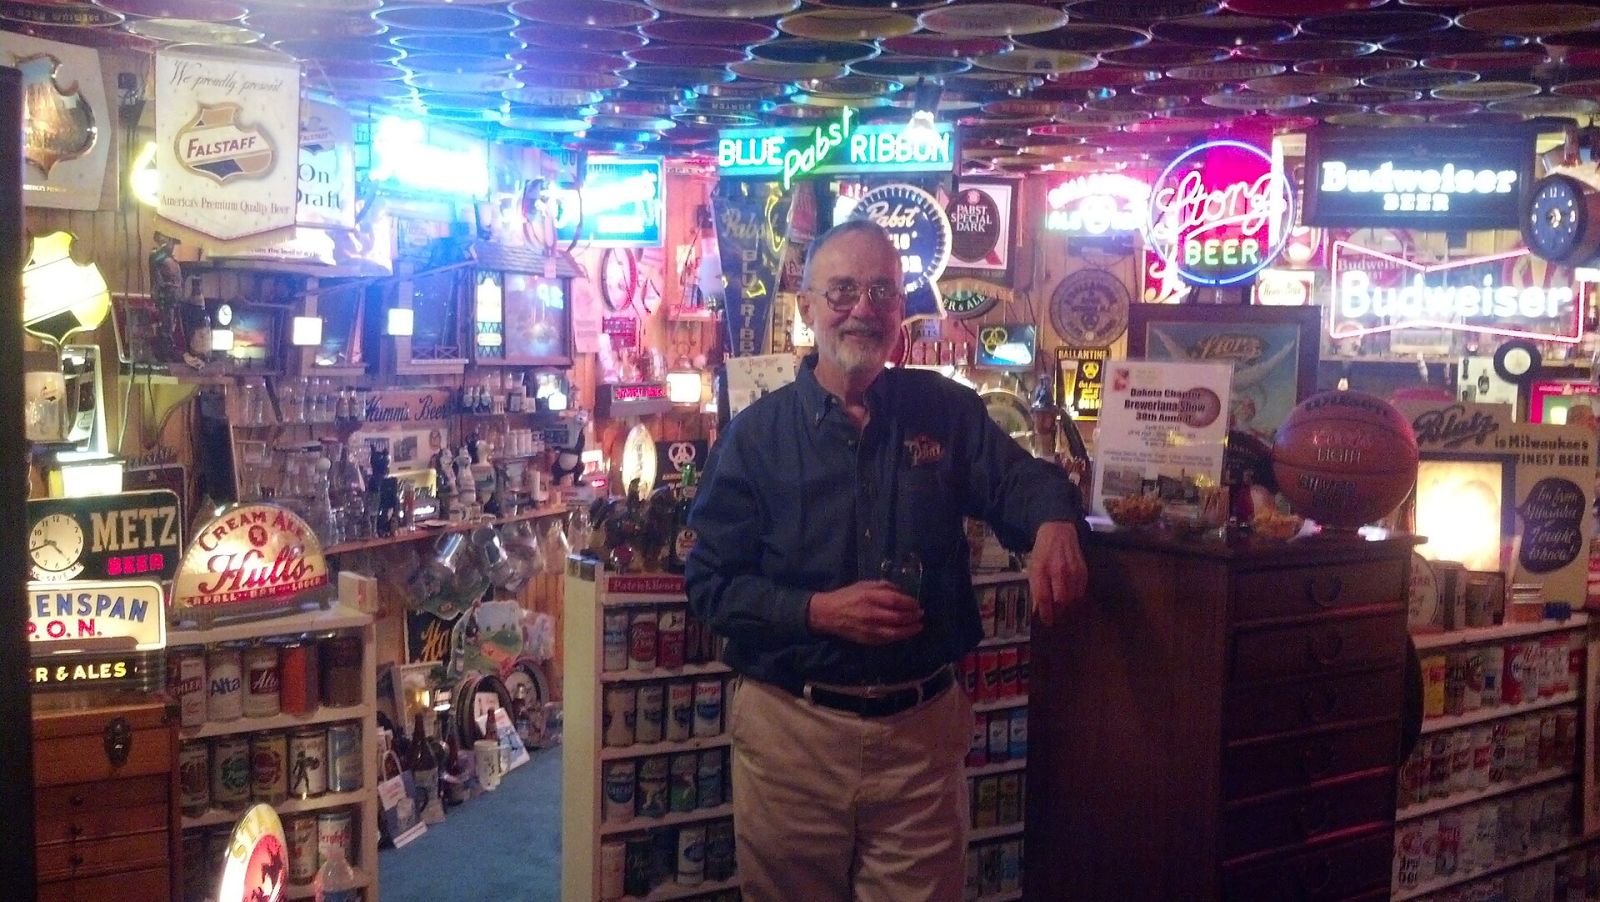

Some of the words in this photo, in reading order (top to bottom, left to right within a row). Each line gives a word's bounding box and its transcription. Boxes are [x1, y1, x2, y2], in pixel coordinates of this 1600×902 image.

[191, 71, 239, 95] proudly
[240, 79, 284, 94] present
[186, 135, 257, 159] FALSTAFF
[718, 136, 786, 168] BLUE
[850, 132, 950, 164] RIBBON
[299, 163, 331, 184] On
[1321, 161, 1518, 194] Budweiser
[201, 196, 238, 210] Premium
[240, 198, 268, 215] Quality
[269, 202, 291, 215] Beer
[956, 204, 988, 215] PABST
[1383, 193, 1450, 212] BEER
[866, 200, 920, 228] Pabst
[951, 213, 993, 225] SPECIAL
[956, 222, 986, 232] DARK
[1184, 239, 1259, 266] BEER
[1341, 271, 1573, 318] Budweiser
[1130, 387, 1163, 398] Dakota
[1164, 388, 1201, 401] Chapter
[364, 395, 409, 423] Hamm's
[415, 394, 448, 420] Beer
[1124, 399, 1178, 412] Breweriana
[1180, 400, 1206, 412] Show
[1158, 411, 1192, 424] Annual
[1495, 437, 1506, 449] is
[1558, 455, 1589, 467] BEER
[90, 505, 177, 553] METZ
[198, 511, 267, 552] CREAM
[108, 553, 164, 576] BEER
[36, 592, 149, 624] ENSPAN
[56, 666, 69, 682] &
[73, 662, 127, 680] ALES
[210, 676, 241, 697] Alta
